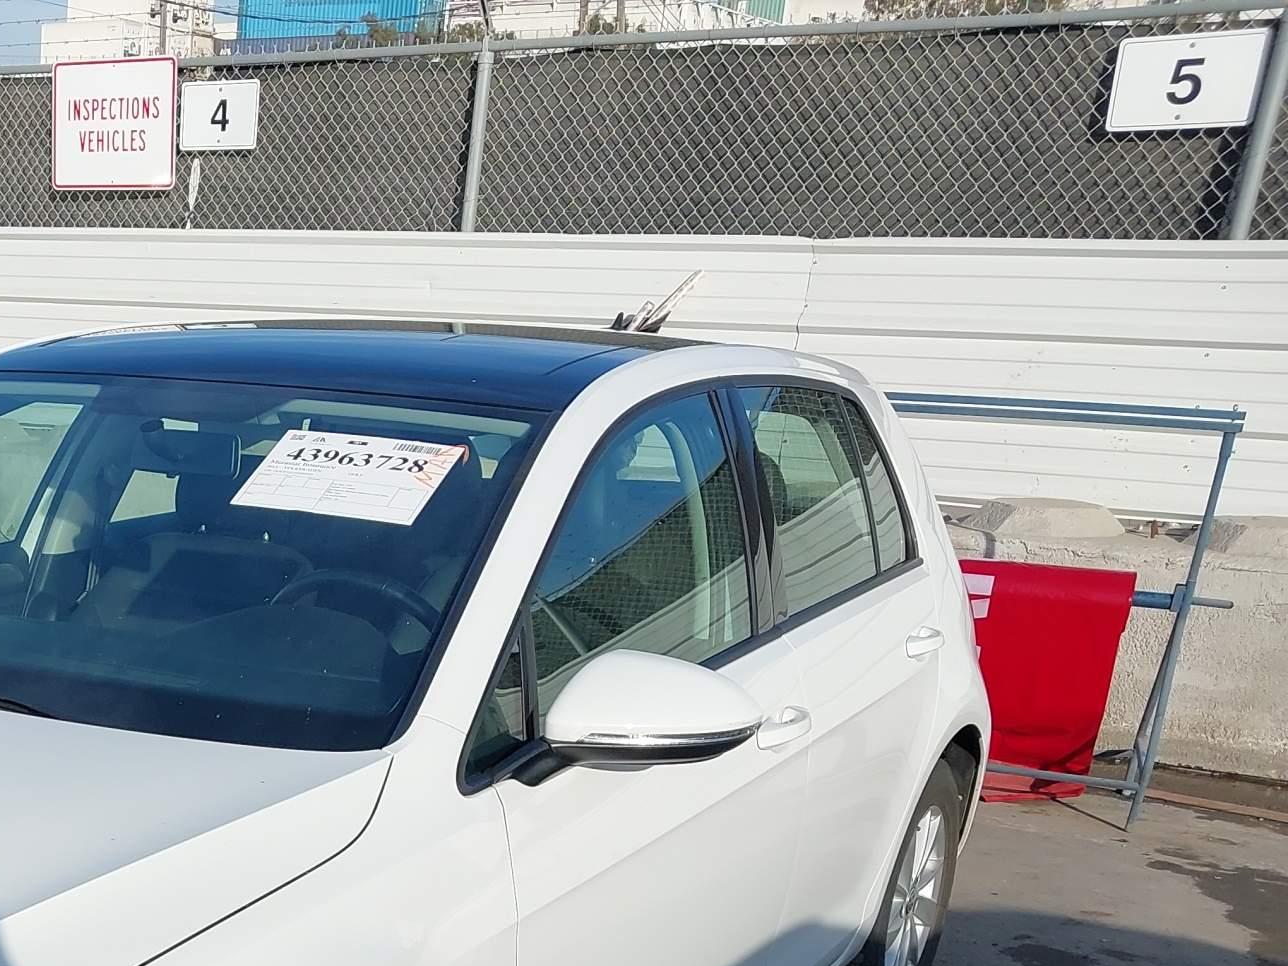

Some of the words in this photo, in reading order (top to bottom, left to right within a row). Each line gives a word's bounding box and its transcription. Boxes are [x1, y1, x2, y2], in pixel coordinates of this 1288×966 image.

[1166, 57, 1206, 105] 5
[67, 96, 160, 121] INSPECTIONS
[210, 99, 230, 132] 4
[79, 129, 146, 153] VEHICLES
[286, 447, 429, 474] 43963728
